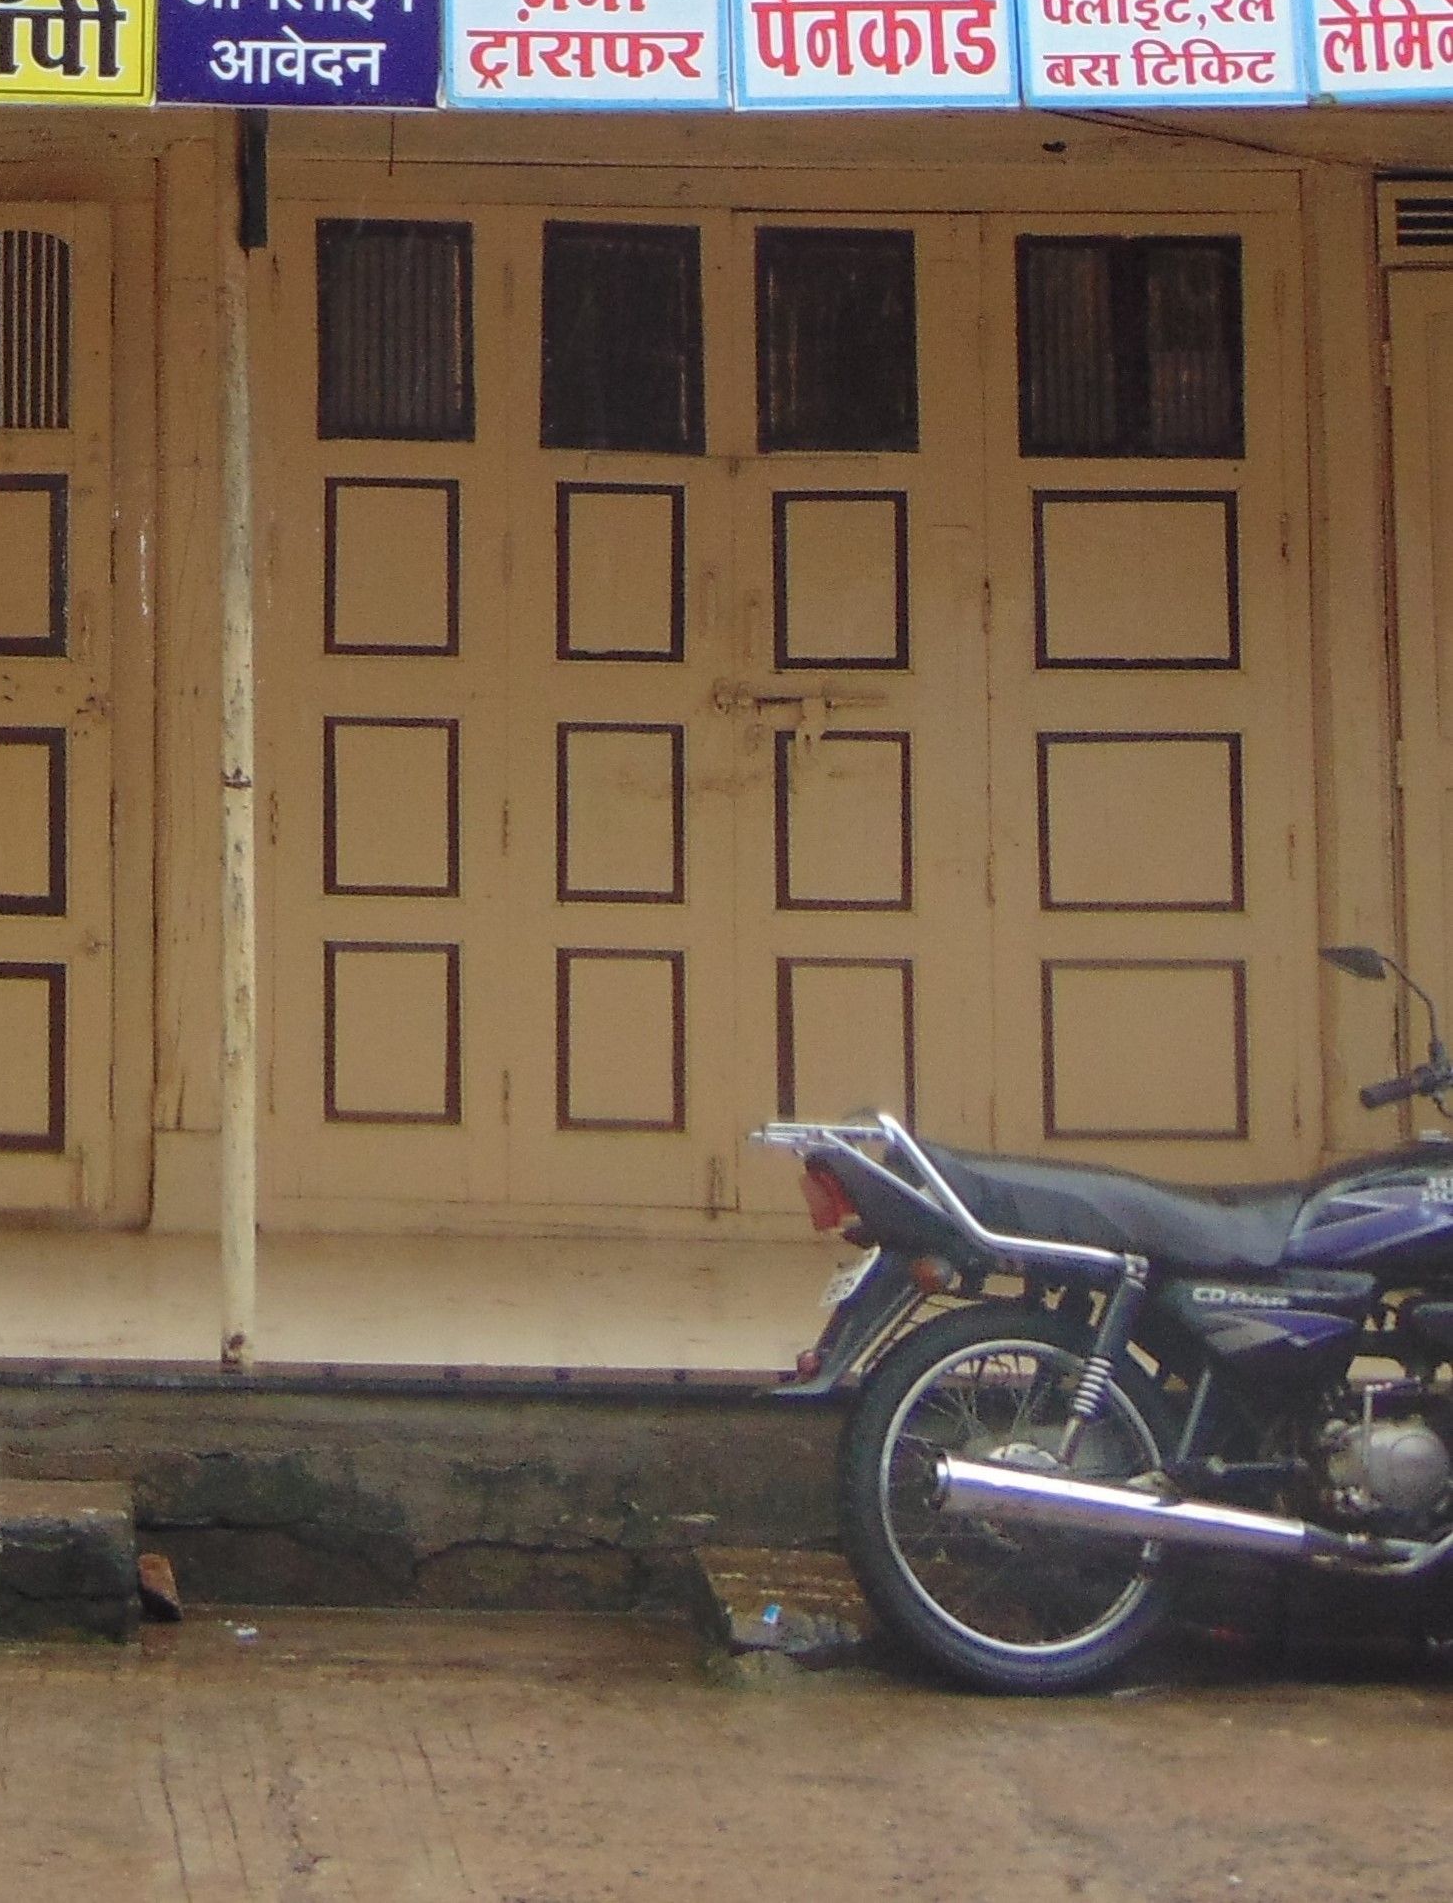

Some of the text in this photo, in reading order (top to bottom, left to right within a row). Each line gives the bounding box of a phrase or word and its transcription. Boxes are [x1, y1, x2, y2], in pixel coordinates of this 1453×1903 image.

[209, 26, 386, 86] आवेदन
[466, 8, 705, 89] ट्रांसफर
[1043, 38, 1276, 87] बस टिकिट
